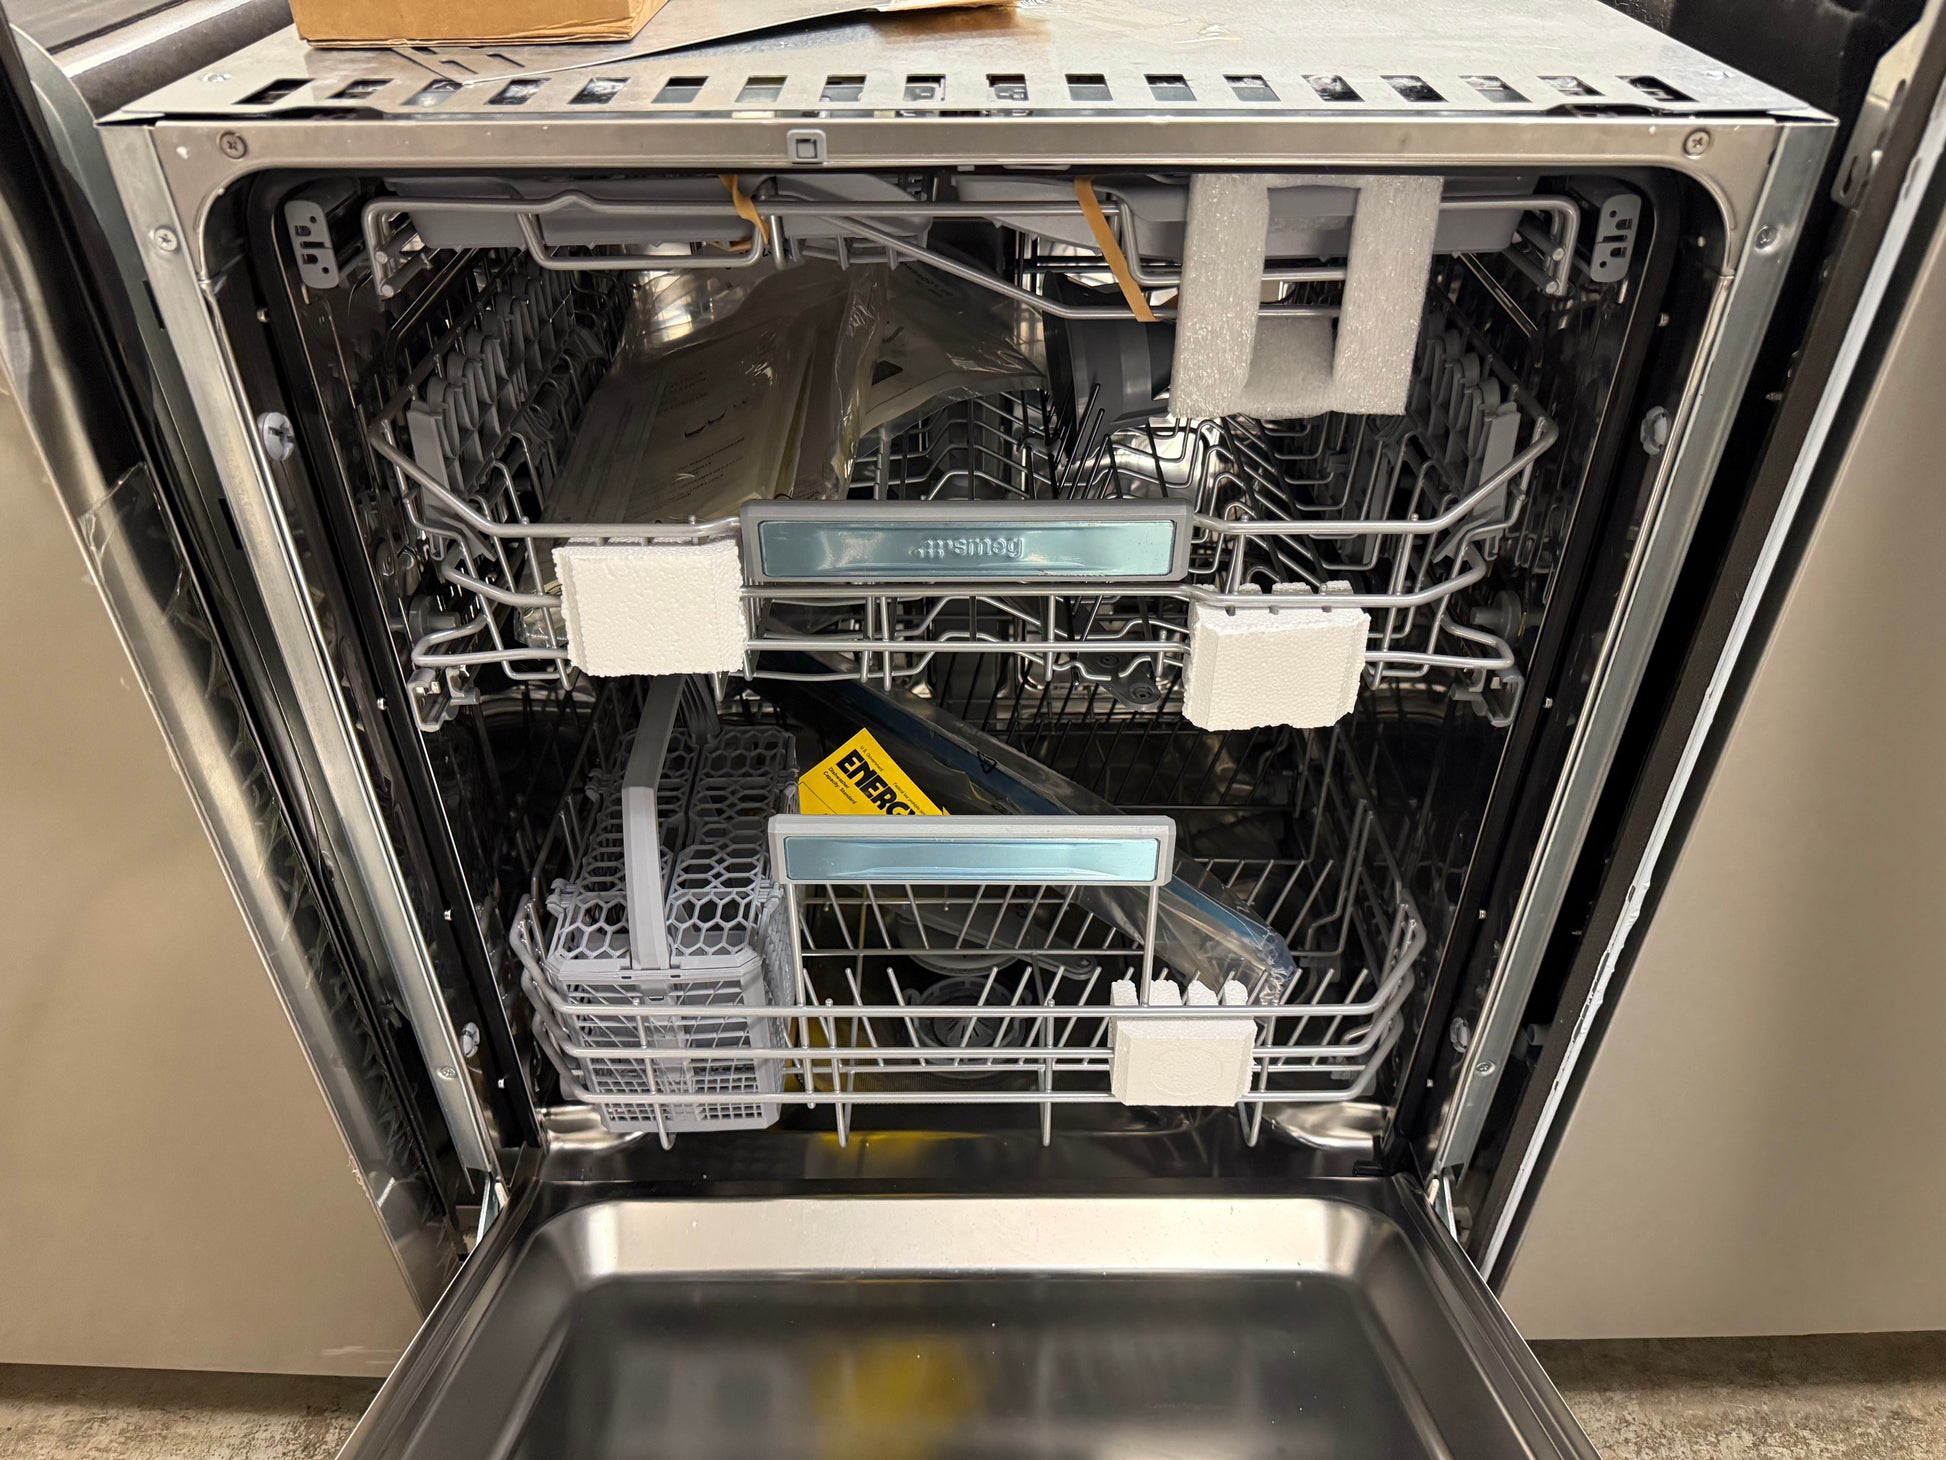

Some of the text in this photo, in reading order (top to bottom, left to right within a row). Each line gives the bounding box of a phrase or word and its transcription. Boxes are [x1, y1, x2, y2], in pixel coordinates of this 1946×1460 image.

[954, 536, 1024, 559] smeg
[865, 752, 884, 772] Government
[822, 771, 857, 805] Capacity: Standard
[827, 766, 849, 789] Dishwasher
